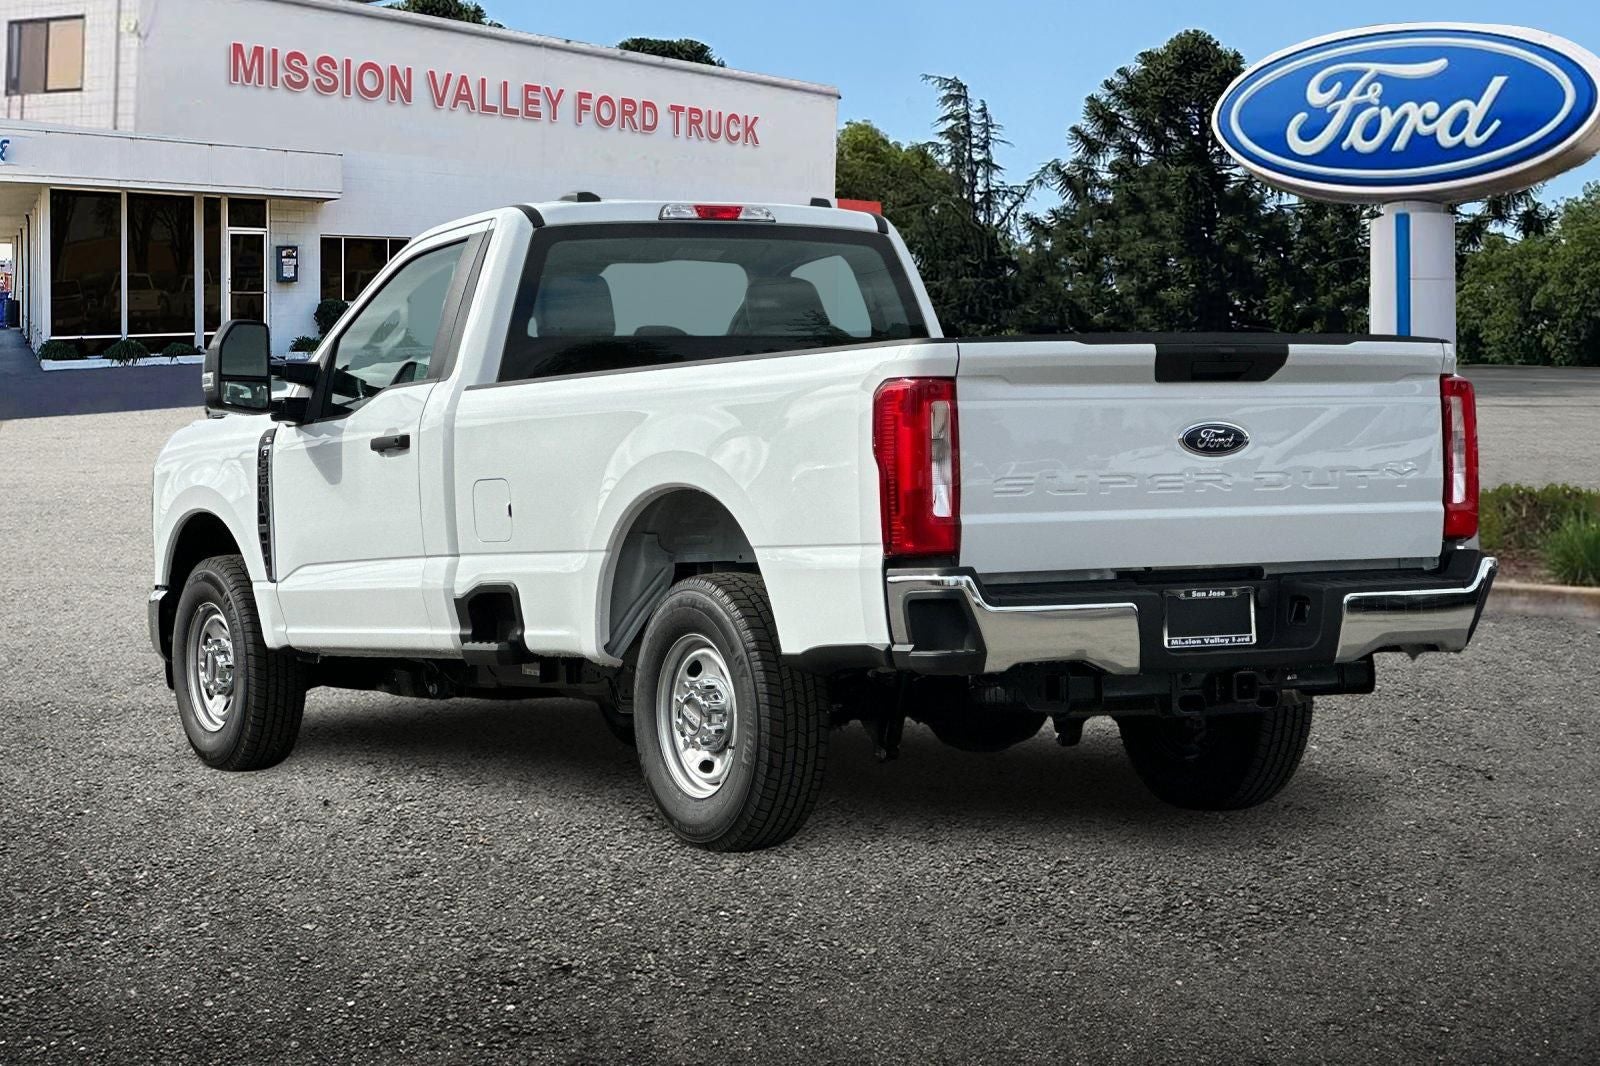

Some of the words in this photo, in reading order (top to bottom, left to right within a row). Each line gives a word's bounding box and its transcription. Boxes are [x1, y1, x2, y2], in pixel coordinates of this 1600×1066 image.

[229, 40, 413, 105] MISSION
[427, 68, 565, 122] VALLEY
[574, 89, 660, 135] FORD
[668, 103, 761, 147] TRUCK
[1286, 57, 1509, 156] Ford
[1196, 428, 1235, 449] Ford
[992, 471, 1233, 498] SUPER
[1253, 461, 1419, 491] DUTY
